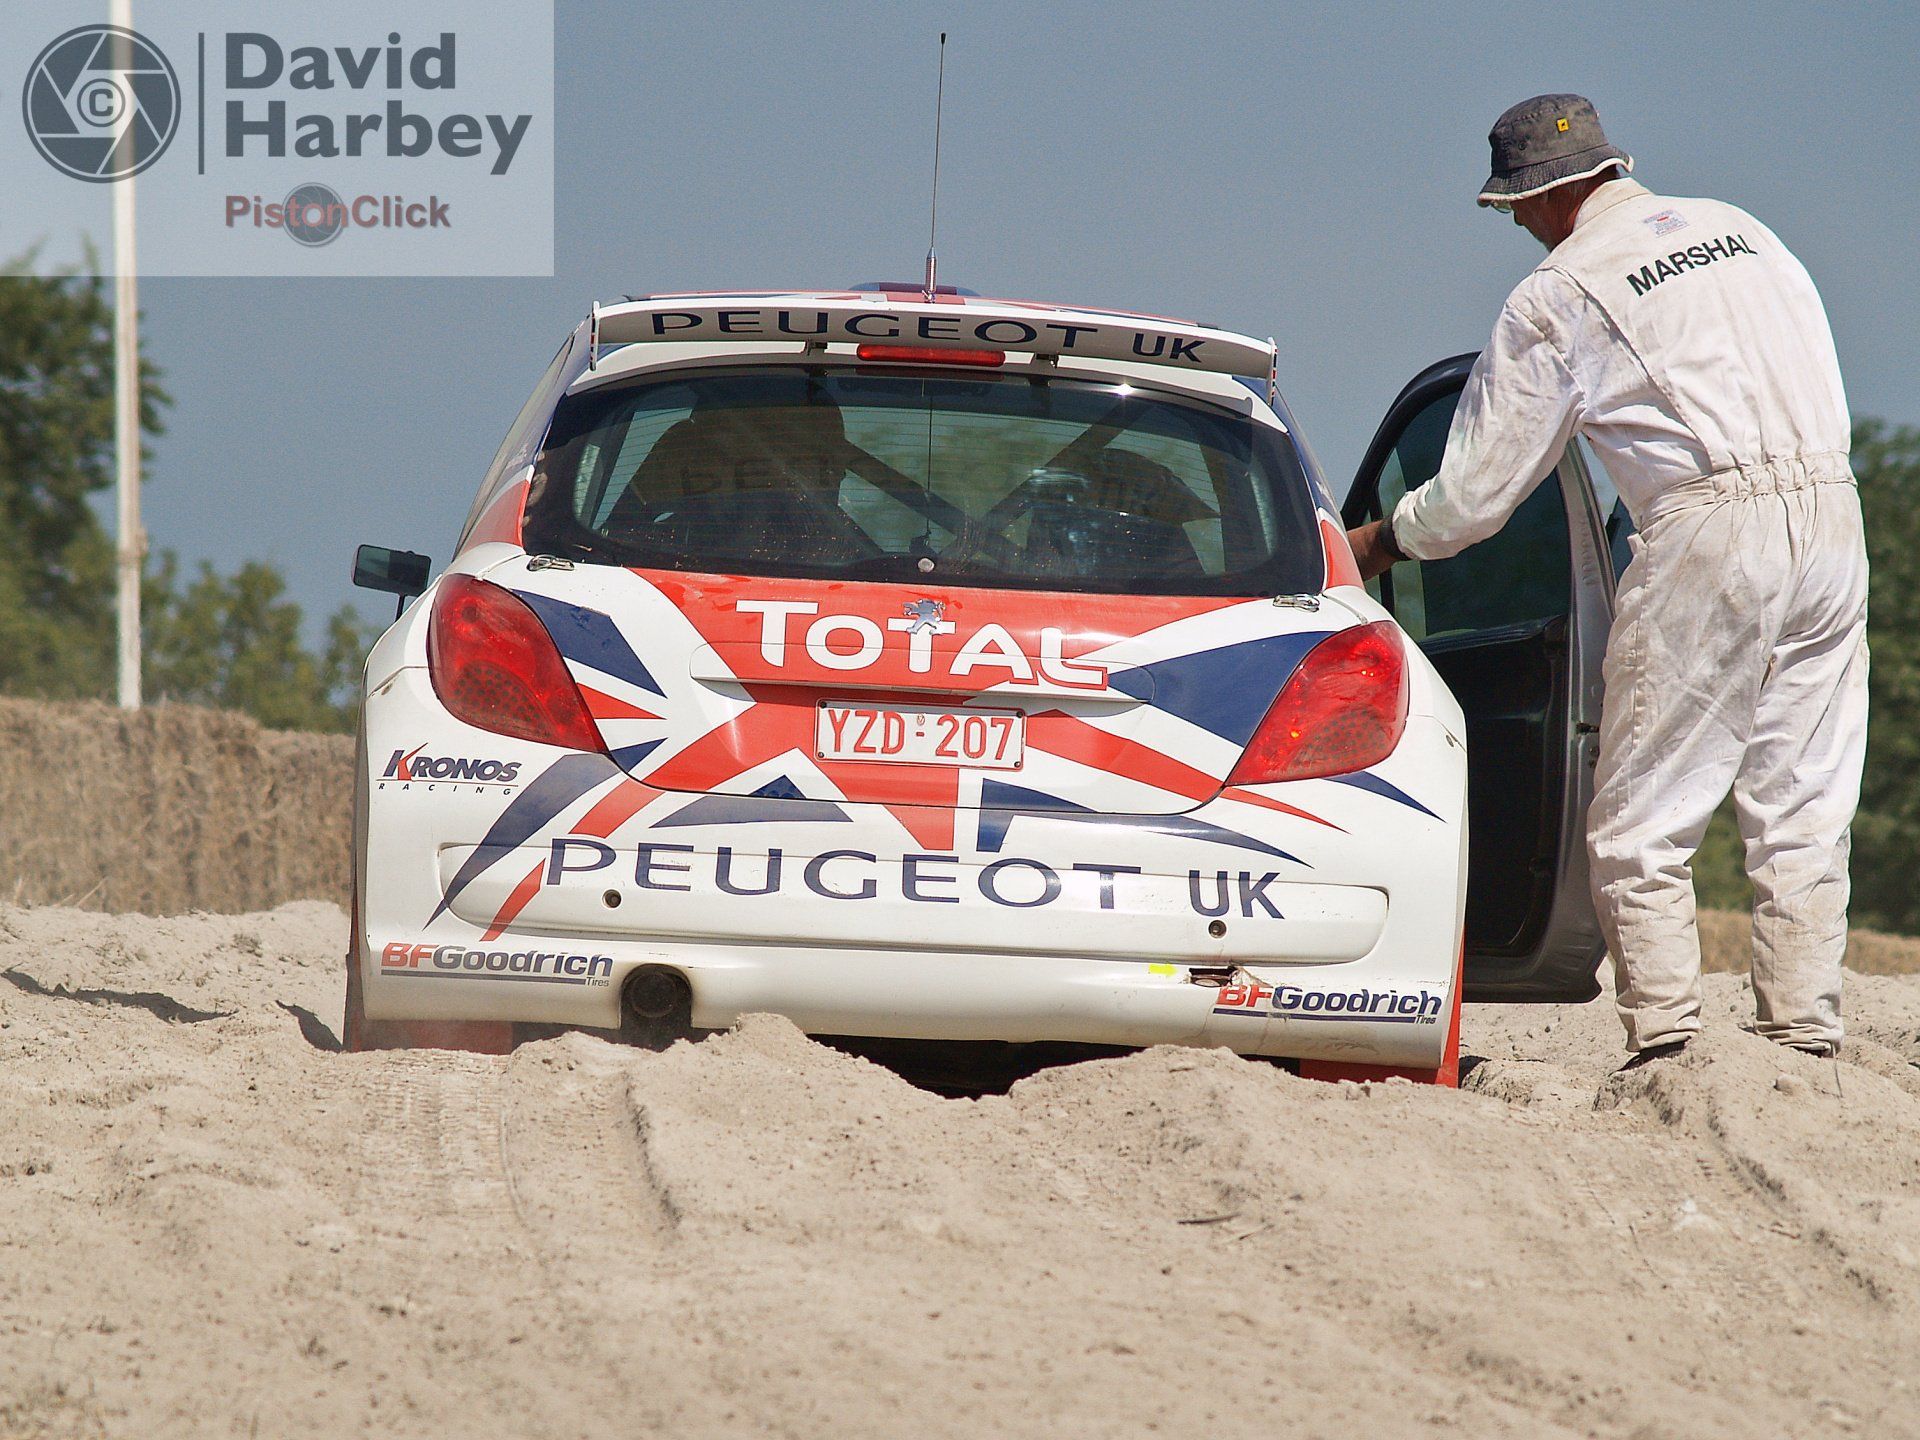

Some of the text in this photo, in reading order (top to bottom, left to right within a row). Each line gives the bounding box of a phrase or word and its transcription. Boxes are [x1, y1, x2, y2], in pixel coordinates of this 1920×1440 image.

[1626, 233, 1758, 297] MARSHAL
[651, 310, 1207, 363] PEUGEOT UK
[735, 599, 1108, 692] TOTAL
[382, 742, 522, 782] KRONOS
[378, 783, 511, 796] RACING
[546, 837, 1285, 920] PEUGEOT UK
[381, 942, 614, 977] BFGoodrich
[585, 976, 610, 988] Tires
[1215, 984, 1443, 1016] BFGoodrich
[1414, 1014, 1437, 1025] Tires
